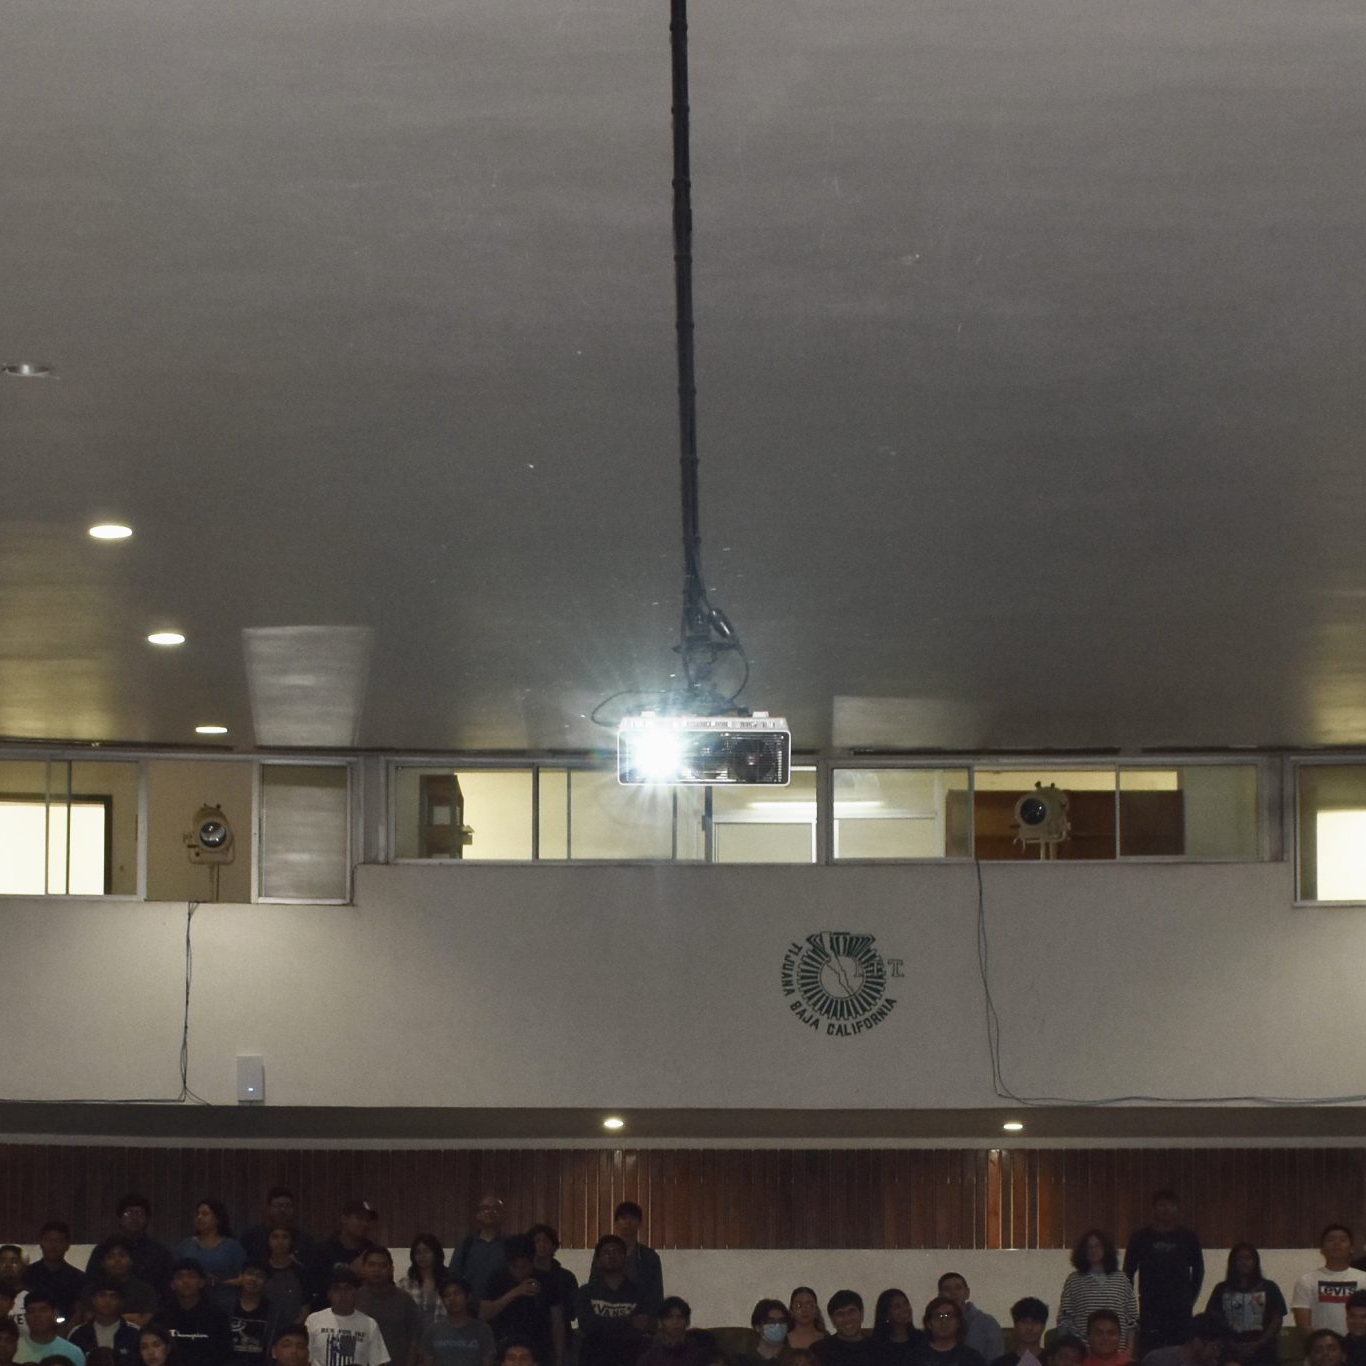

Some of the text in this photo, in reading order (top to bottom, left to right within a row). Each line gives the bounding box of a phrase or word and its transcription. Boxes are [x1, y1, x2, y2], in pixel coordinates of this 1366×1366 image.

[781, 942, 804, 997] TIJUANA
[790, 998, 897, 1037] BAJA CALIFORNIA
